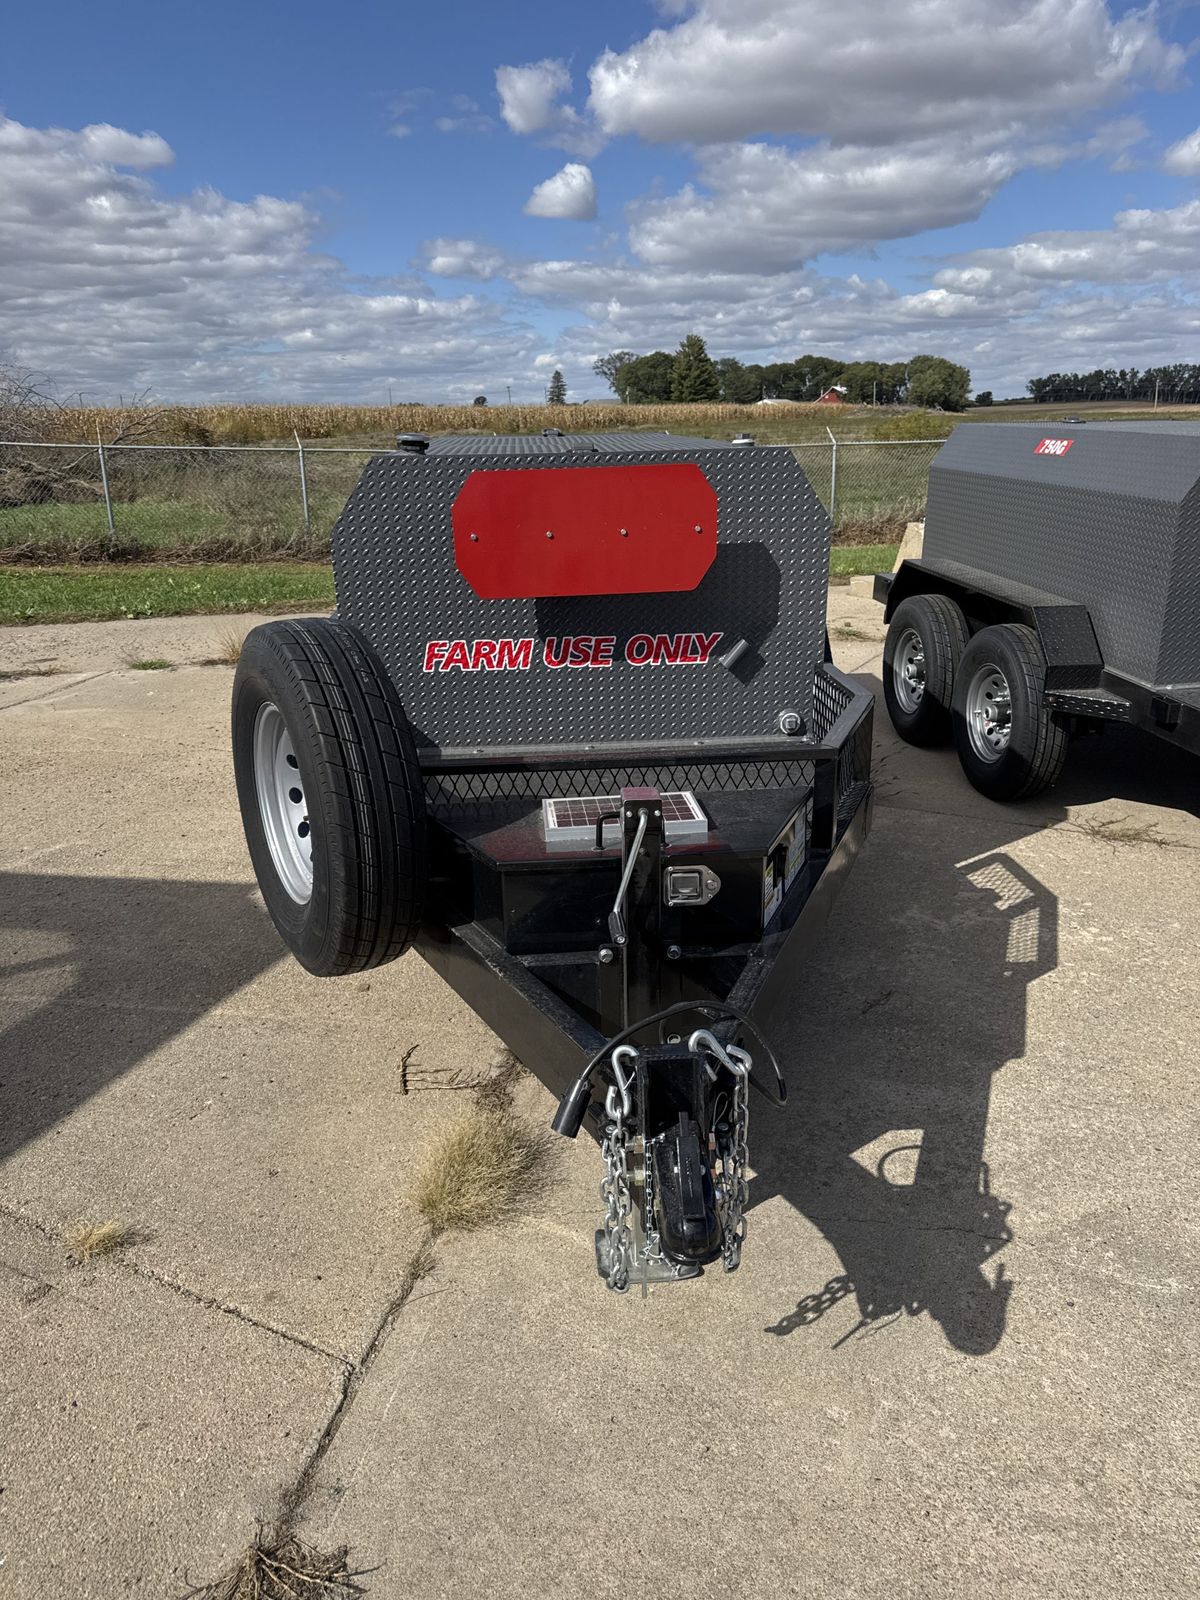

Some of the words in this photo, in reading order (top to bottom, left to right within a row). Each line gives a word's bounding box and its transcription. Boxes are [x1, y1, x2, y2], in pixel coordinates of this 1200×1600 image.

[1039, 439, 1069, 455] 750G
[423, 638, 535, 672] FARM
[543, 635, 616, 668] USE
[625, 632, 724, 666] ONLY
